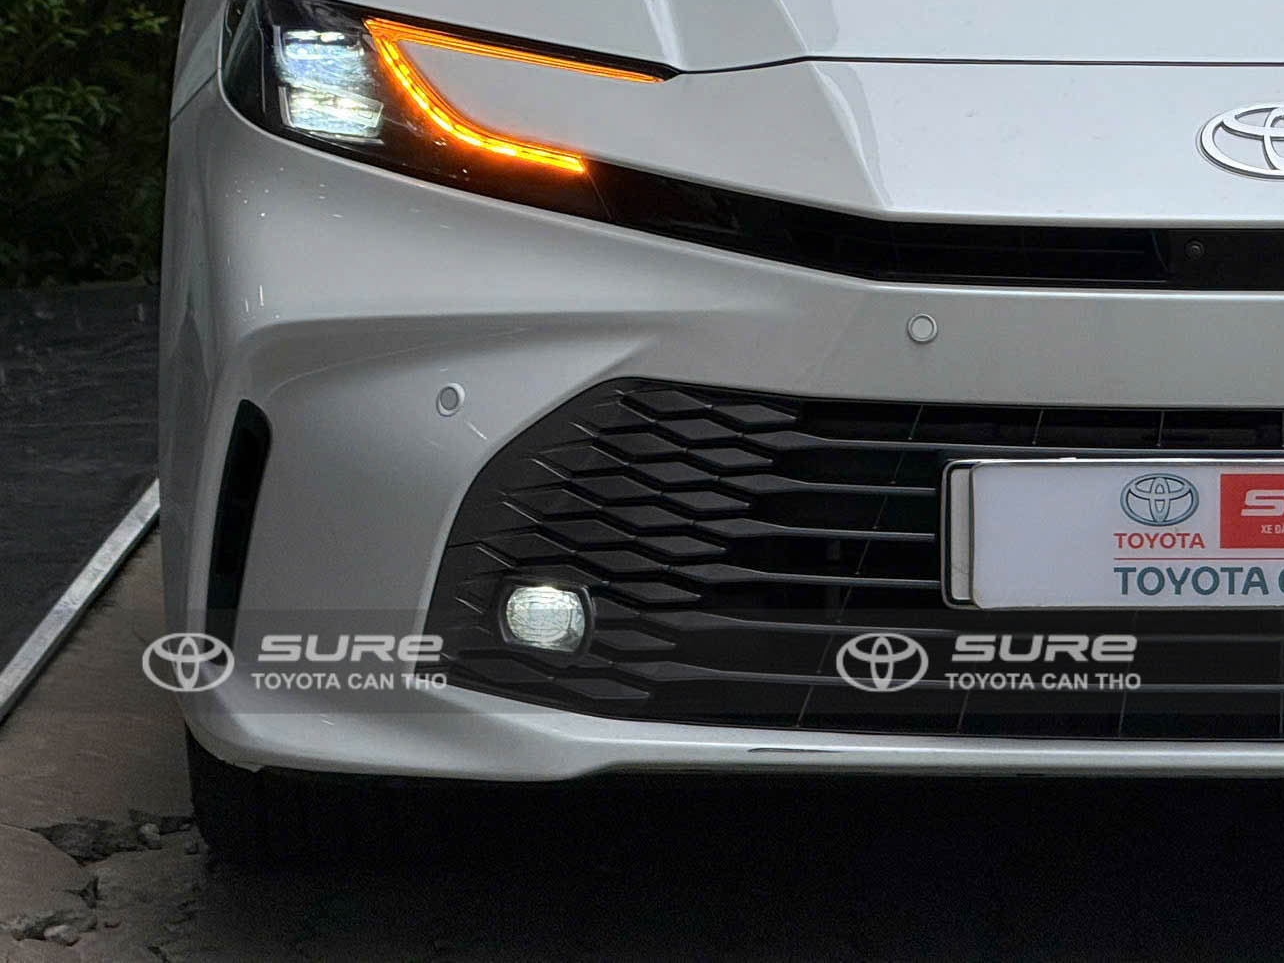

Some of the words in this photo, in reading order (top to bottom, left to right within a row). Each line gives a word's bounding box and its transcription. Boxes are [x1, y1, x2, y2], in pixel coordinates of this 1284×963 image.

[1261, 524, 1273, 535] XE
[1114, 532, 1206, 550] TOYOTA
[1114, 566, 1269, 596] TOYOTA
